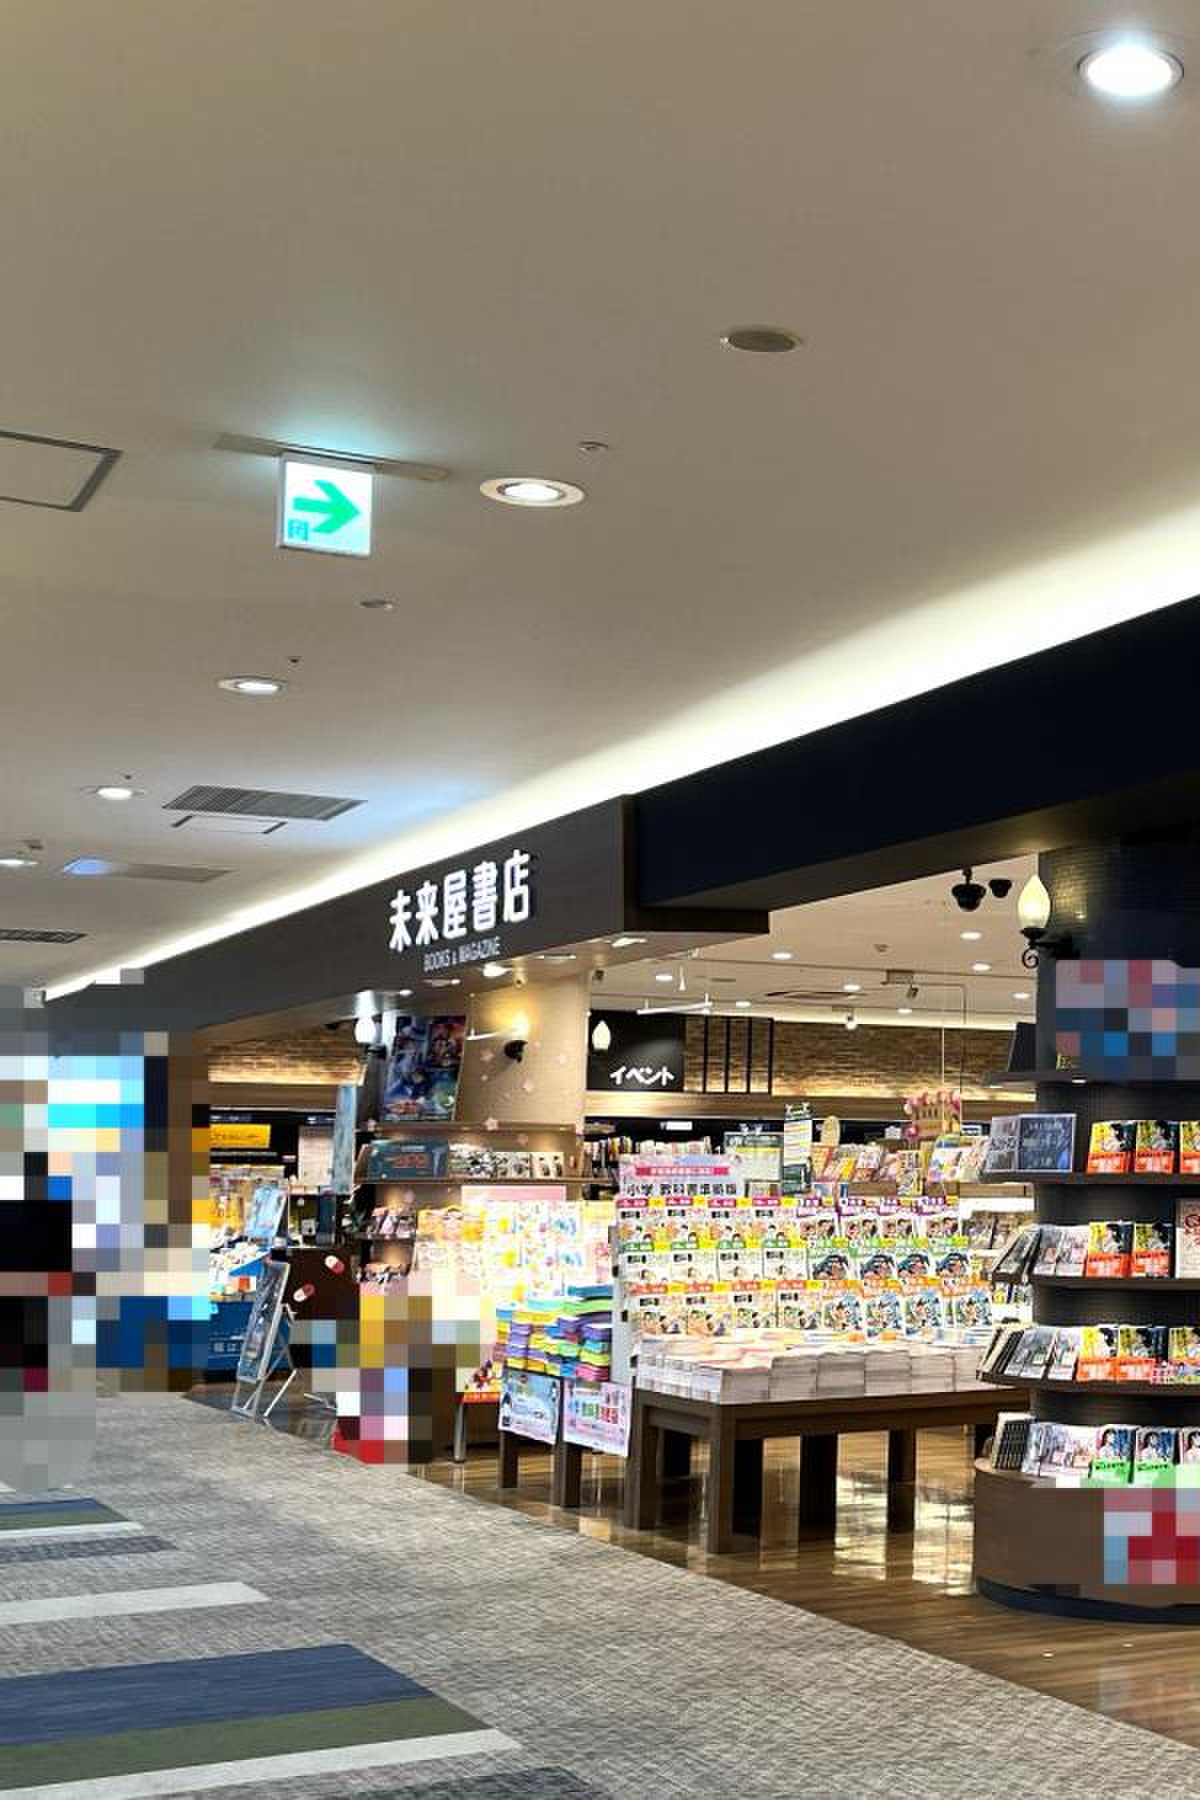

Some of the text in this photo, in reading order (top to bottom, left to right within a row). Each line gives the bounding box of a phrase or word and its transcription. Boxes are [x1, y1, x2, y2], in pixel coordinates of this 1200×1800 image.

[389, 849, 530, 952] 未来屋書店
[423, 949, 450, 972] BOOKS
[460, 936, 500, 963] MAGAZINE
[610, 1066, 675, 1086] イベント
